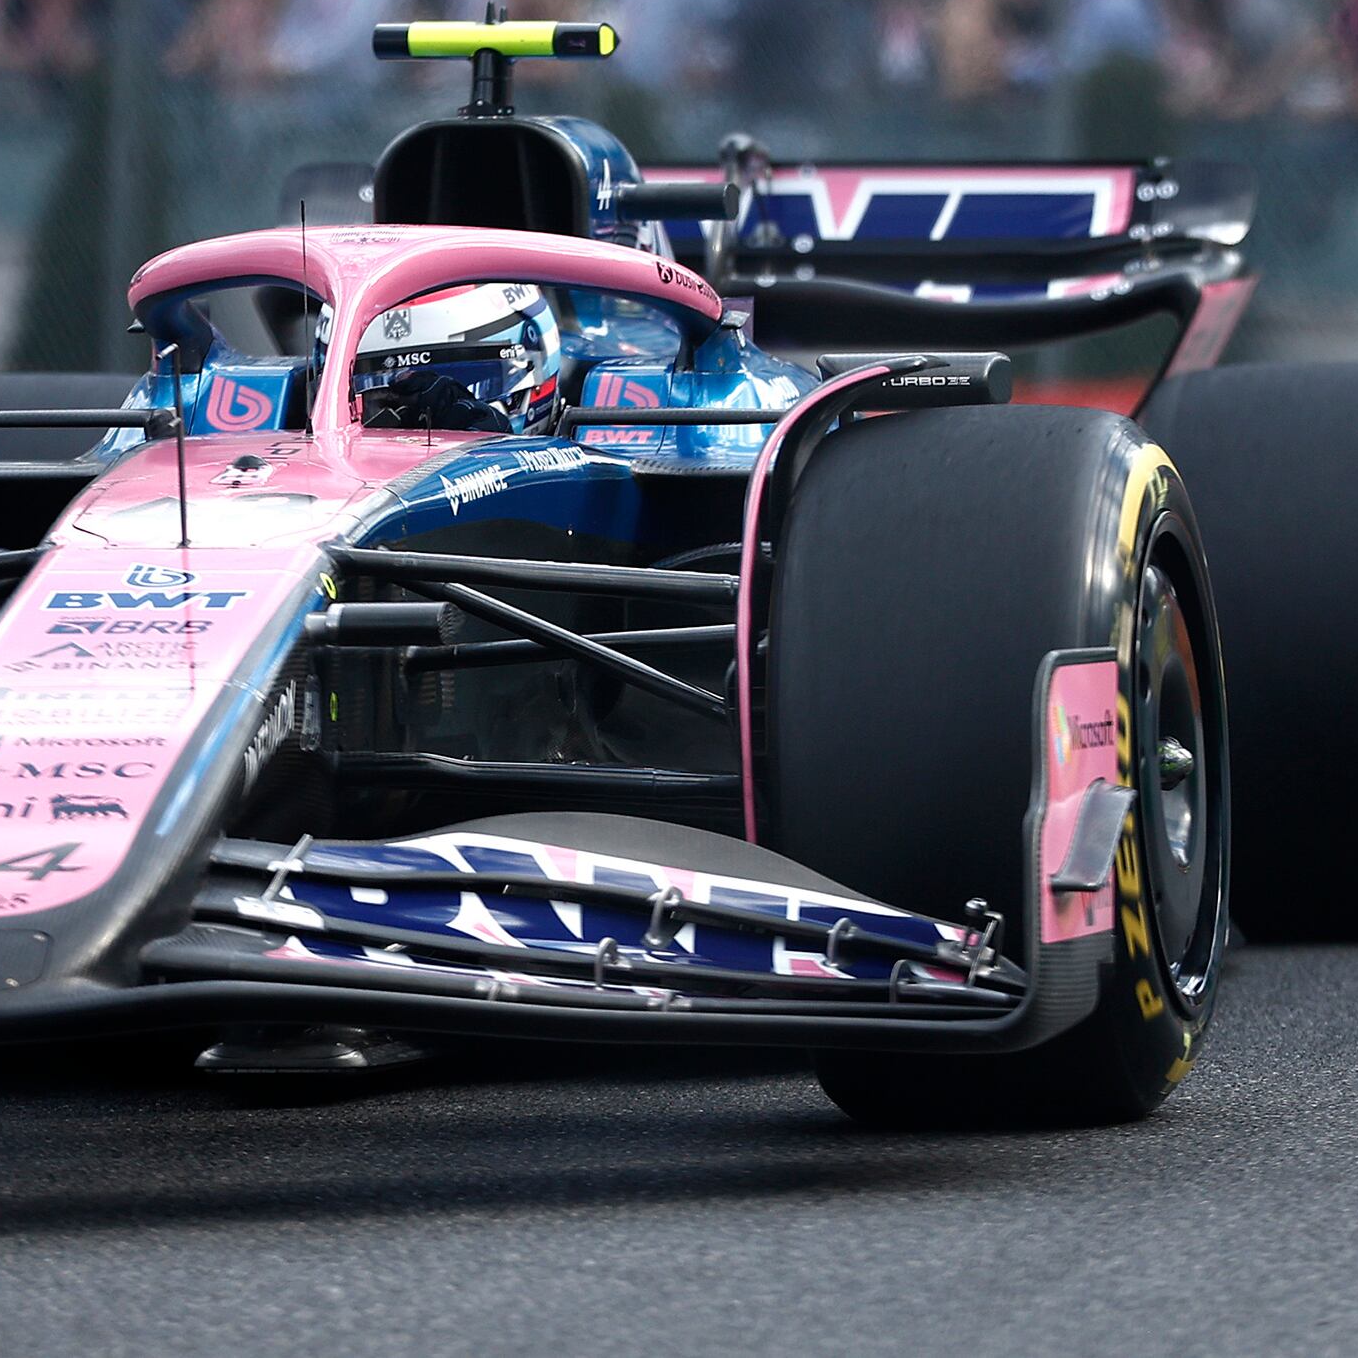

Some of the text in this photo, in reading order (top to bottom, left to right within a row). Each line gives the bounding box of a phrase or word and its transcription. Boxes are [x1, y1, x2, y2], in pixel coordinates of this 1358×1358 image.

[397, 351, 431, 368] MSC
[499, 345, 517, 359] eni
[584, 429, 654, 444] BWT
[458, 464, 508, 505] BINANCE
[46, 592, 247, 609] BWT
[103, 620, 214, 635] BRB
[51, 661, 207, 671] BINANCE
[15, 737, 167, 748] Microsoft
[13, 761, 156, 779] MSC
